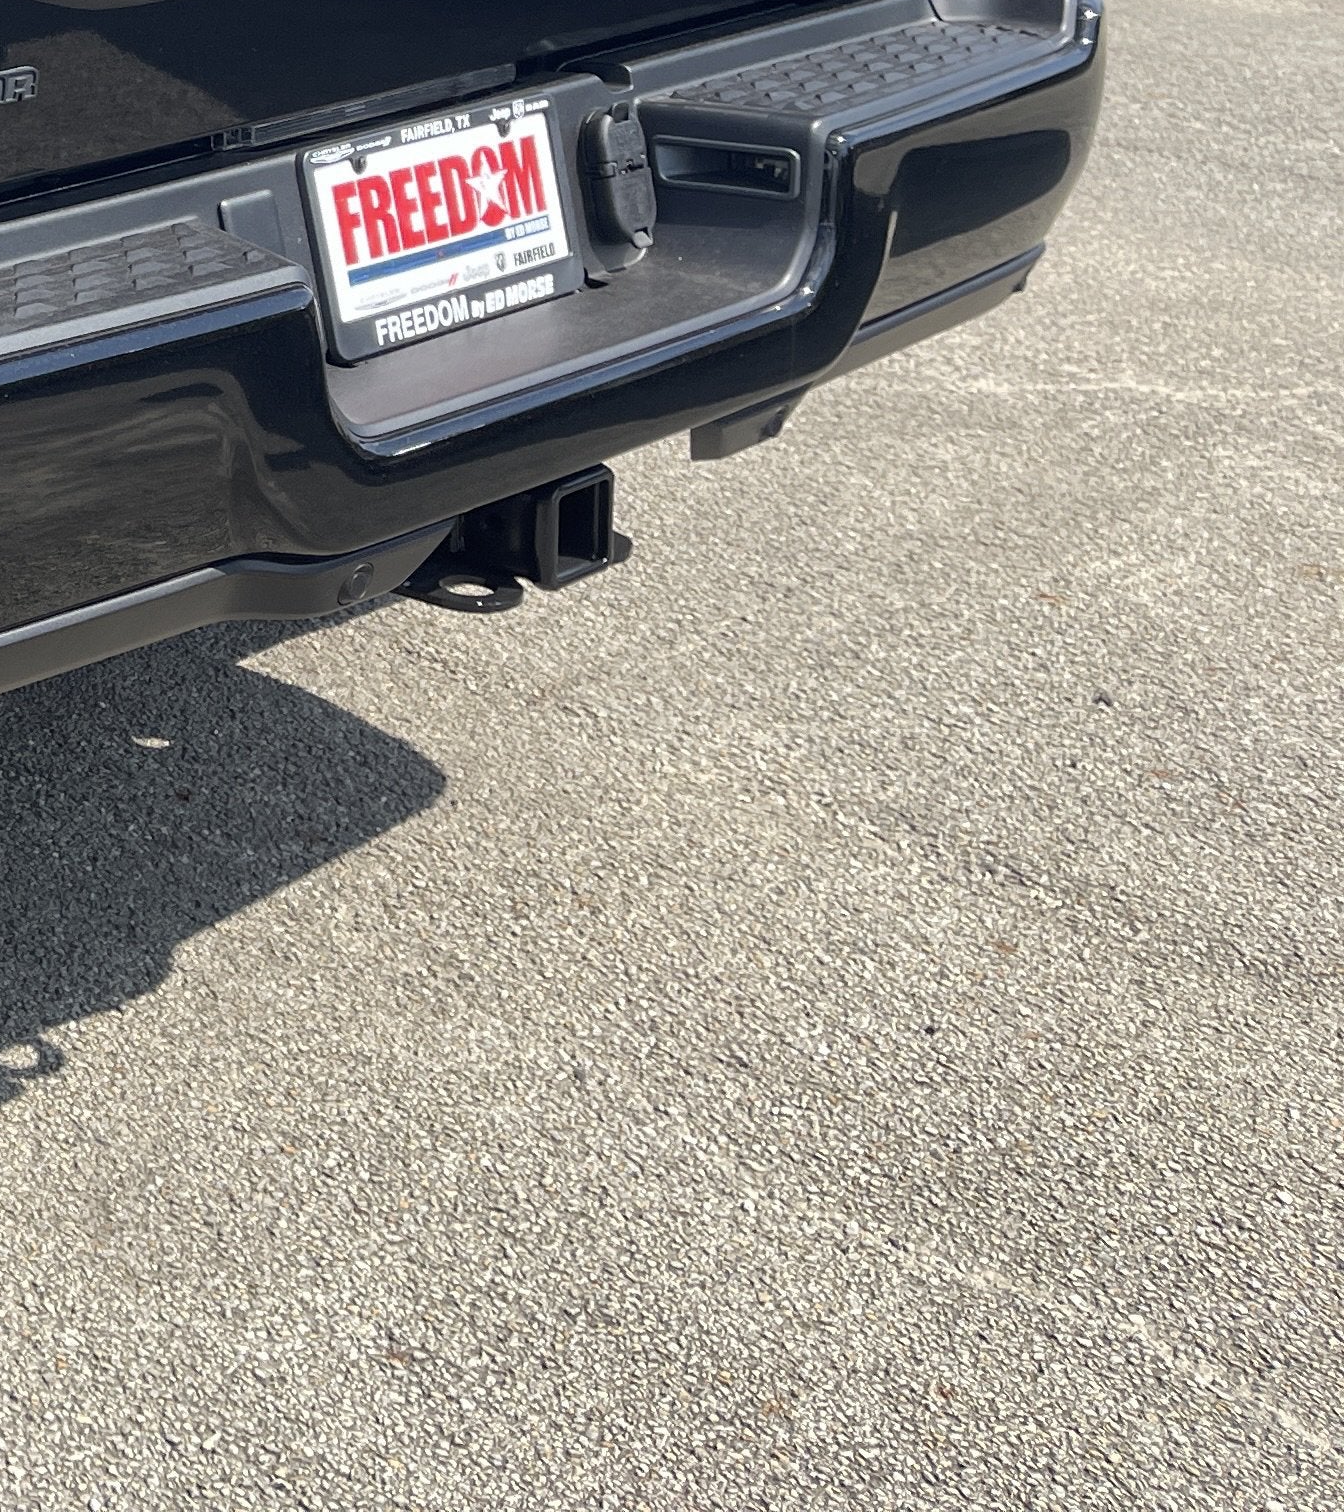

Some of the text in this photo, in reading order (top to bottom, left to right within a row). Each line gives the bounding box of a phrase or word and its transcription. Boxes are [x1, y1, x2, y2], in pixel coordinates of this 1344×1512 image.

[455, 113, 471, 129] TX
[331, 134, 547, 266] FREEDOM
[513, 242, 555, 266] FAIRFIELD
[374, 294, 470, 347] FREEDOM
[485, 289, 505, 314] ED
[505, 274, 555, 308] MORSE
